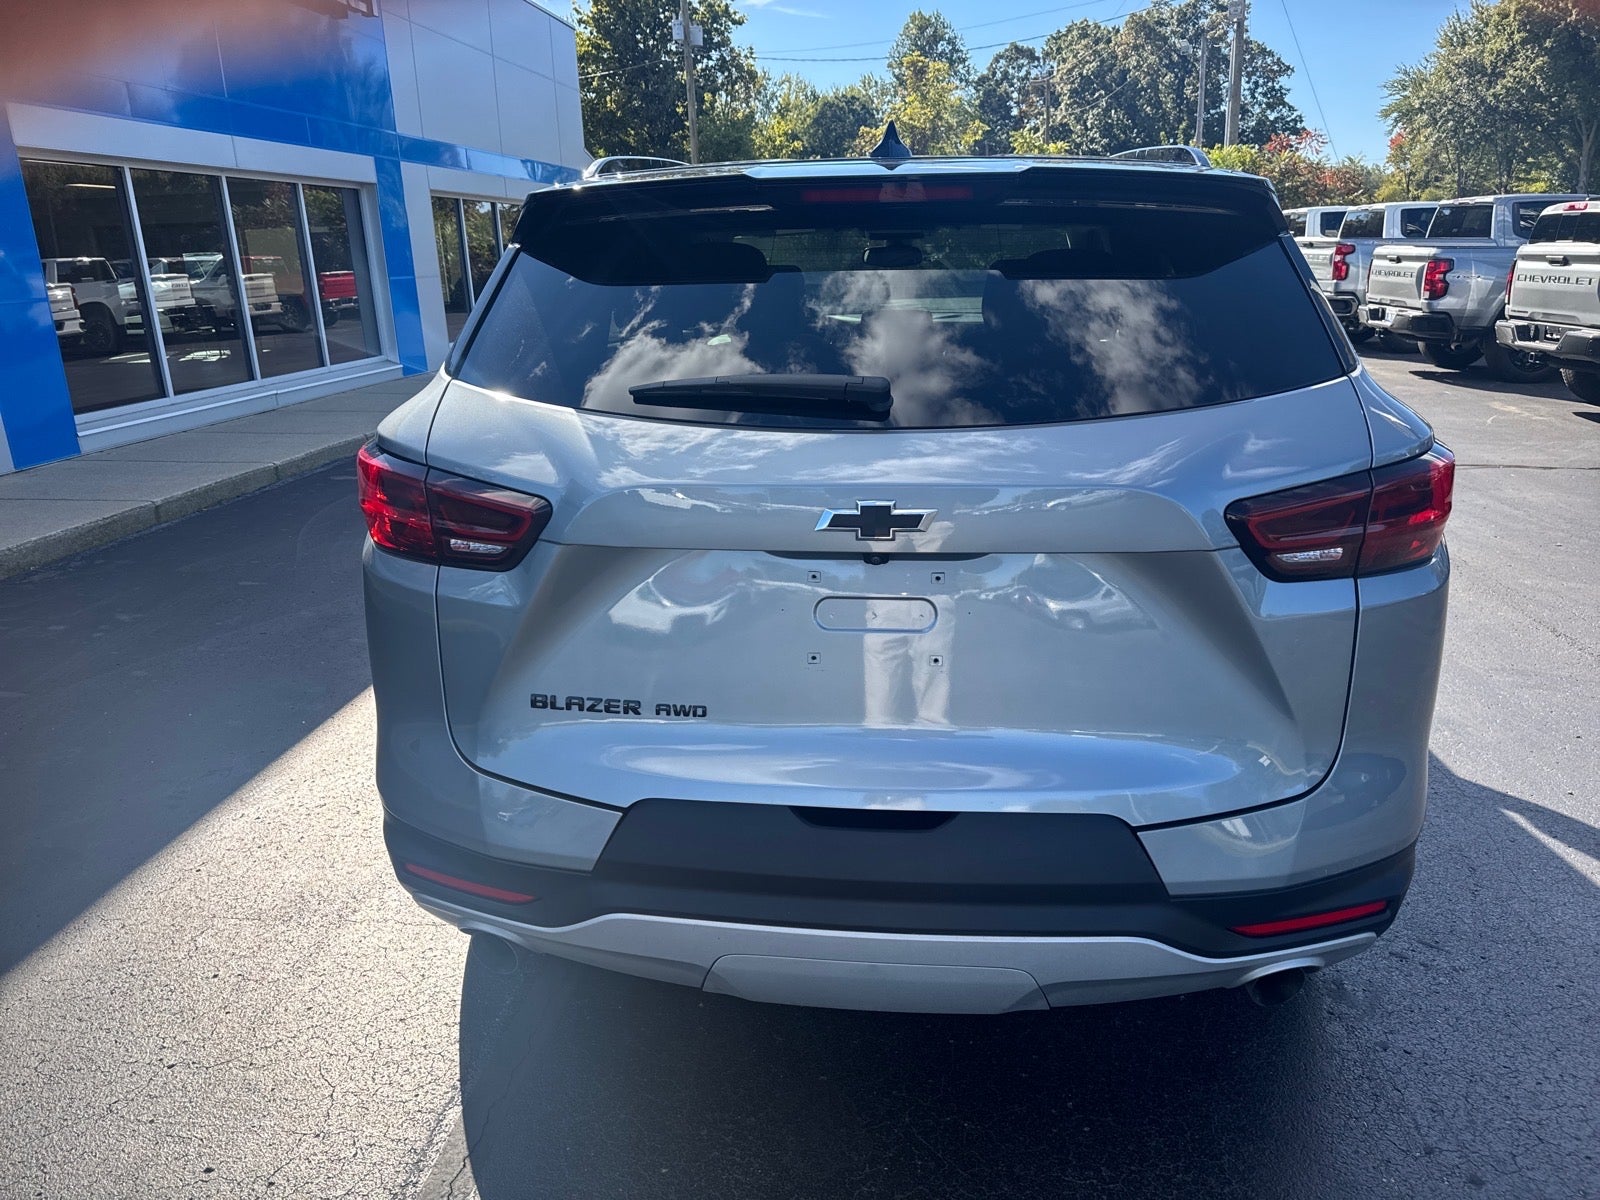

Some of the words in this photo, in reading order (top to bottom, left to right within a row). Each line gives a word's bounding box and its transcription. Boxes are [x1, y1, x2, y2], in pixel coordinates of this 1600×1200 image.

[1371, 269, 1416, 279] CHEVROLET
[1517, 273, 1596, 286] CHEVROLET
[530, 693, 642, 716] BLAZER
[655, 703, 707, 718] AWD
